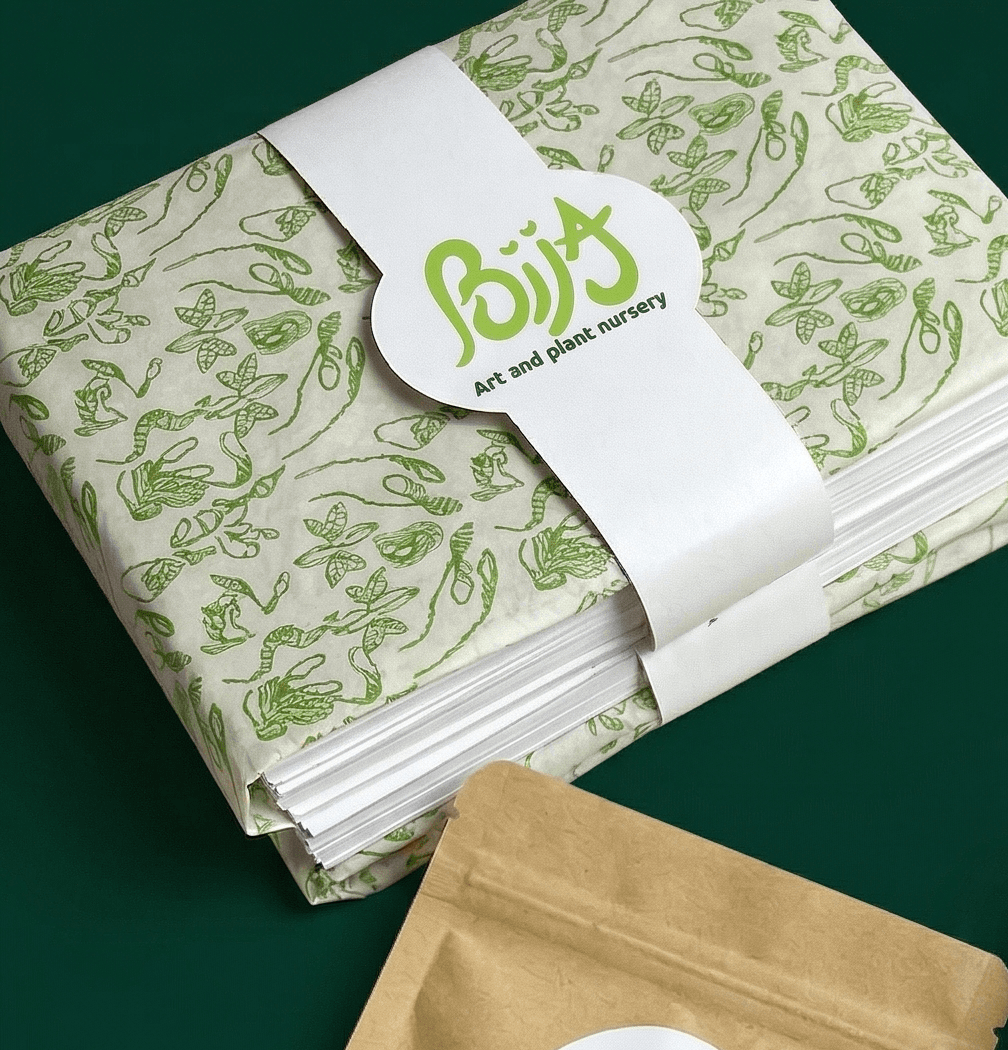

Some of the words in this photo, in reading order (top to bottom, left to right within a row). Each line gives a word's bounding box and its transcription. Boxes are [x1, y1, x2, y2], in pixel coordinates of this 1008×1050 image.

[474, 372, 507, 397] Art
[508, 350, 544, 378] and
[546, 327, 597, 363] plant
[597, 291, 667, 334] nursery
